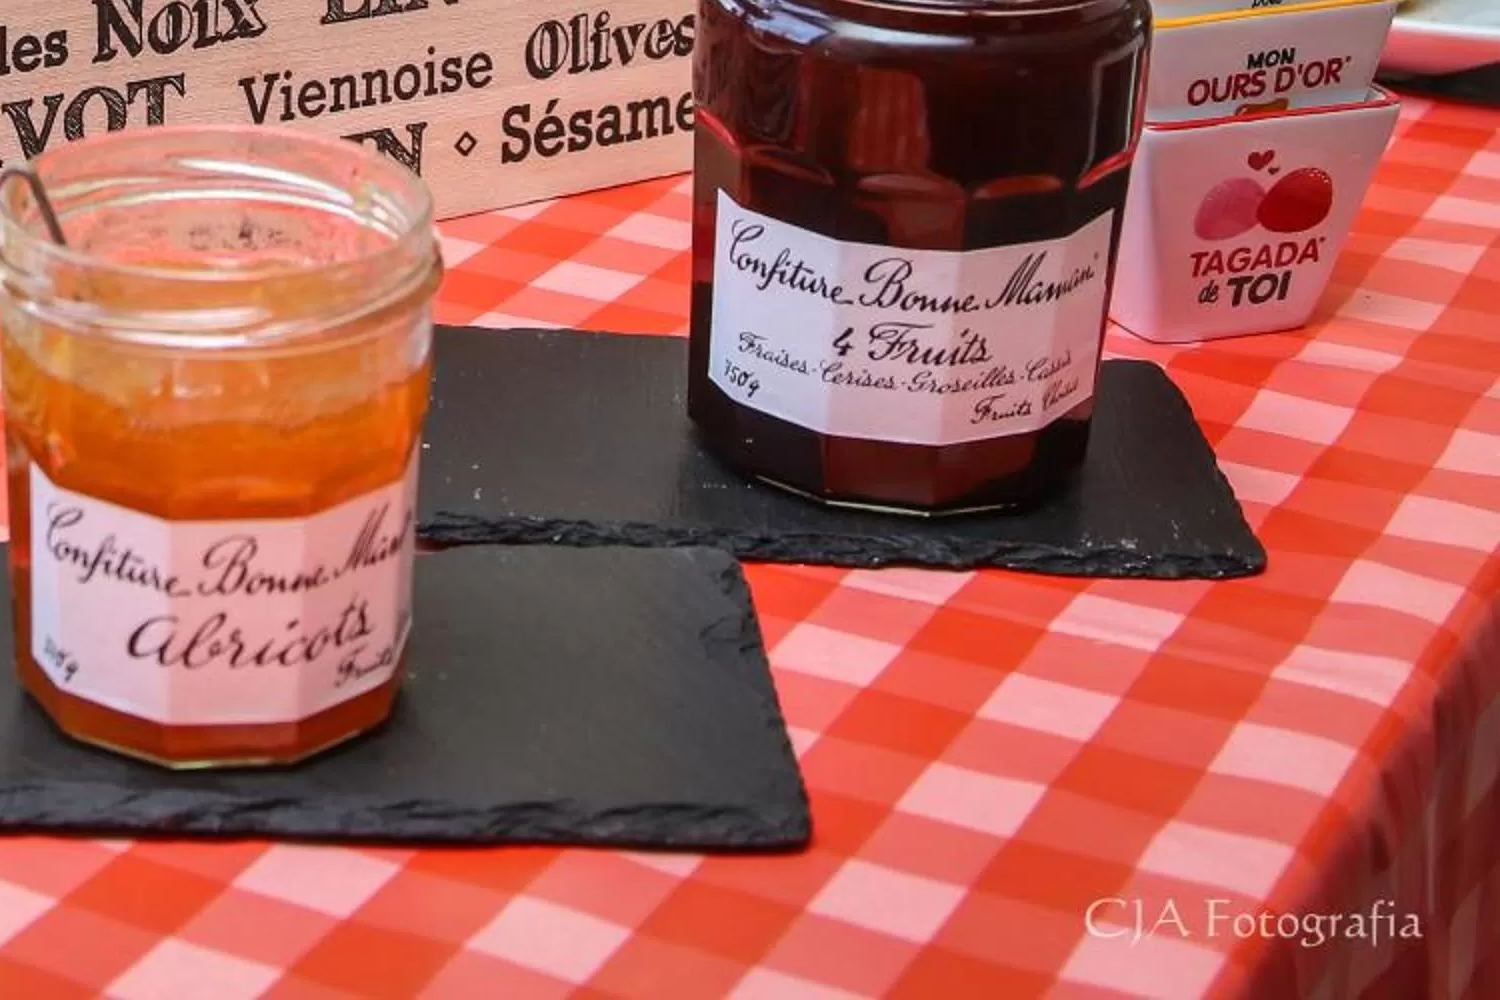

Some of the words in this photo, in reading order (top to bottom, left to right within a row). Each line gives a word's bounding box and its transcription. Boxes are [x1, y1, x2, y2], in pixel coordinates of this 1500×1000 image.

[238, 45, 494, 125] Viennoise
[525, 10, 696, 81] Olives
[1187, 69, 1266, 107] OURS
[1247, 47, 1296, 70] MON
[501, 91, 696, 165] Sésame
[729, 219, 854, 304] Confiture
[858, 256, 981, 314] Bonne
[1197, 279, 1220, 304] de
[1227, 270, 1292, 308] TOI
[832, 327, 856, 357] 4
[867, 321, 994, 368] Fruits
[46, 502, 191, 598] Confiture
[198, 534, 330, 598] Bonne
